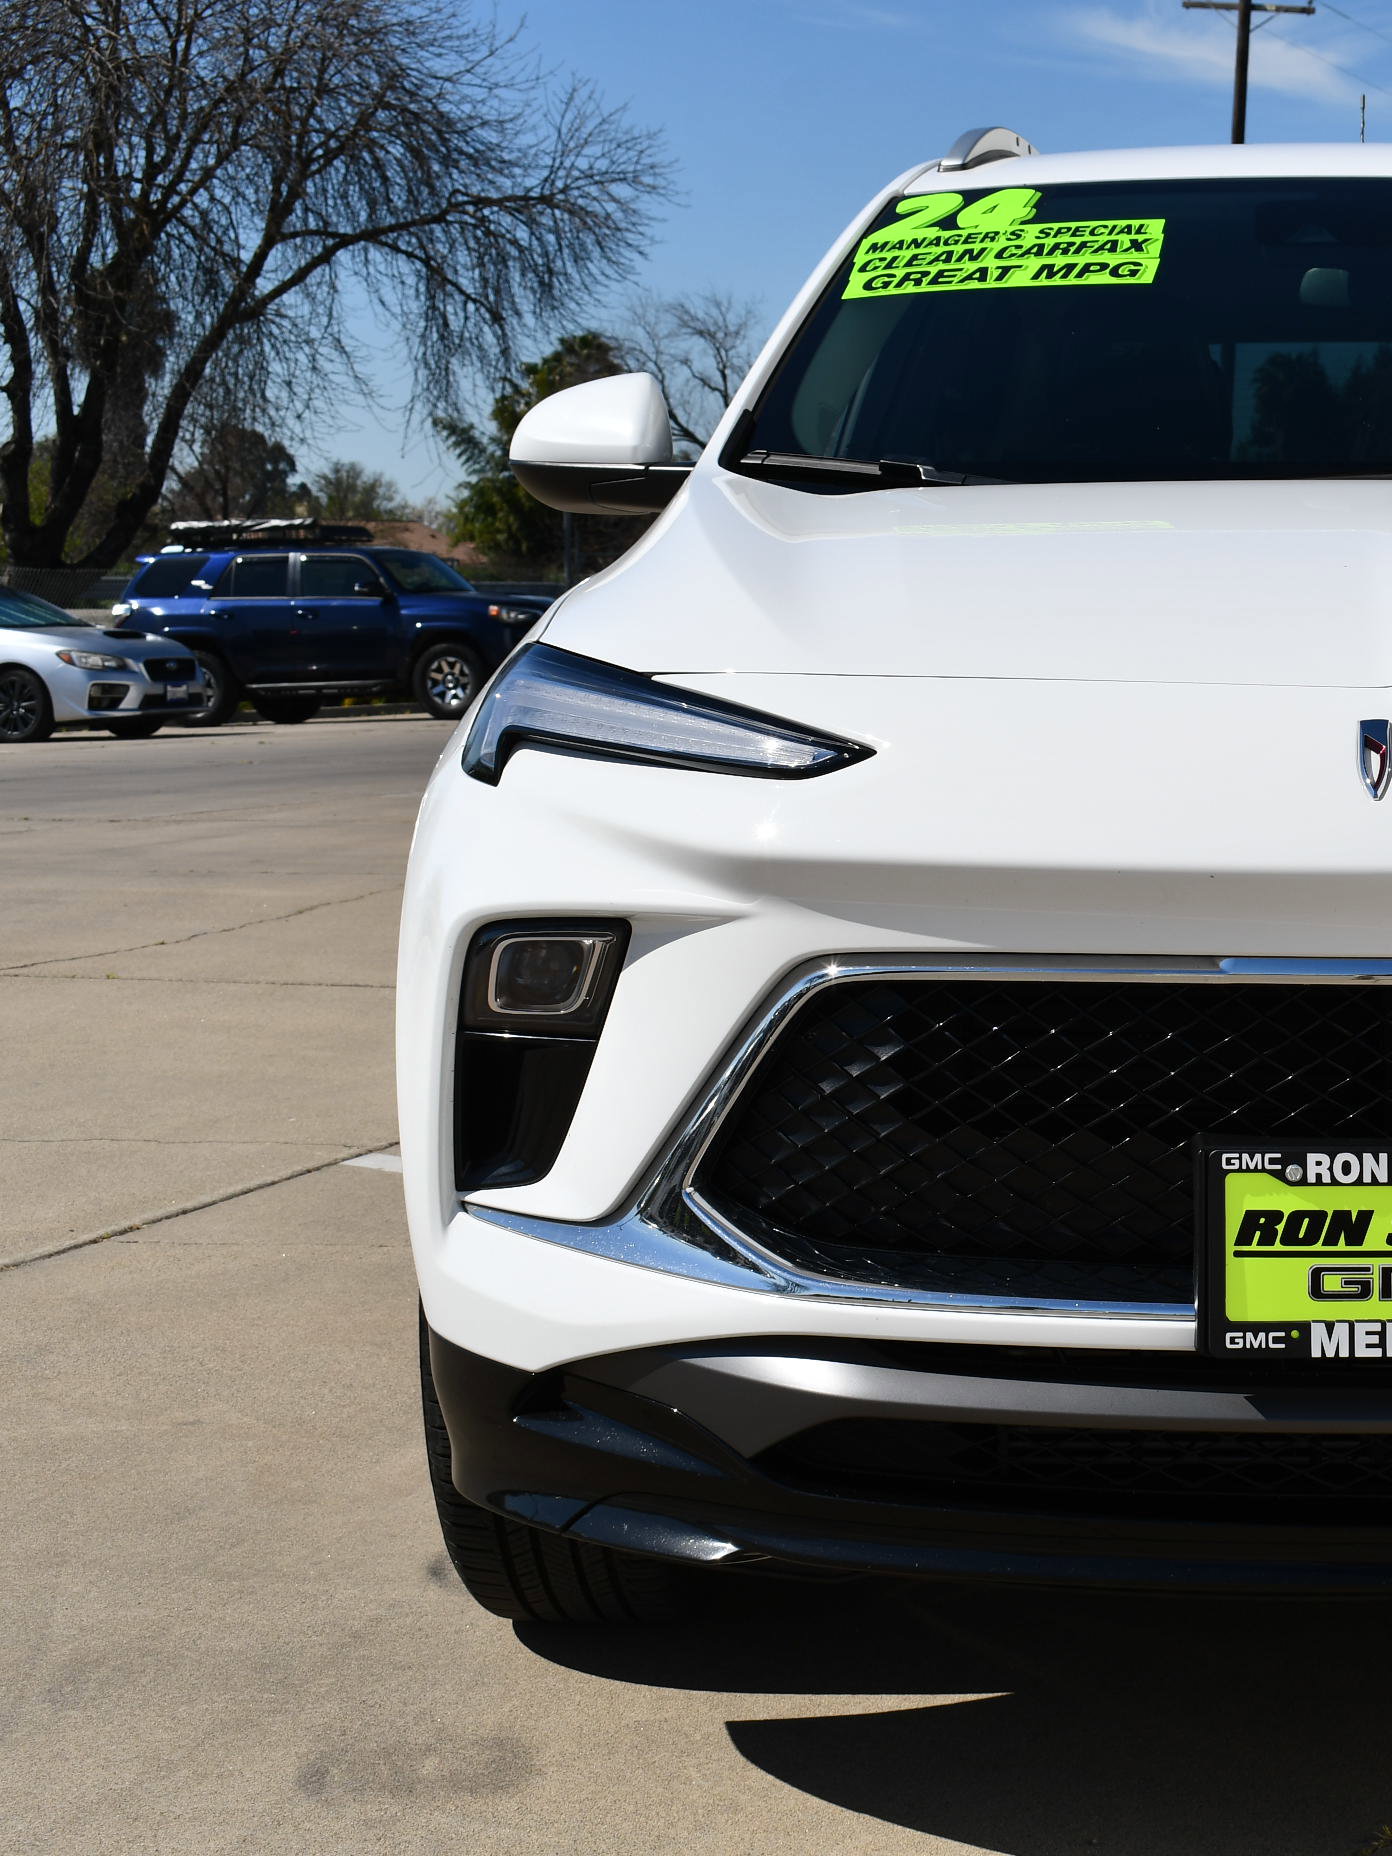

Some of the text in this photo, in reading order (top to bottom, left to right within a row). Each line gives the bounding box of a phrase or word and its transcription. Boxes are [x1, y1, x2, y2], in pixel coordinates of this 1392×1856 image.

[868, 188, 1042, 234] 24
[863, 223, 1150, 255] MANAGER'S SPECIAL
[857, 238, 1159, 274] CLEAN CARFAX
[861, 261, 1144, 291] GREAT MPG
[1221, 1153, 1282, 1170] GMC
[1306, 1152, 1388, 1183] RON
[1233, 1208, 1375, 1247] RON
[1225, 1331, 1286, 1349] GMC
